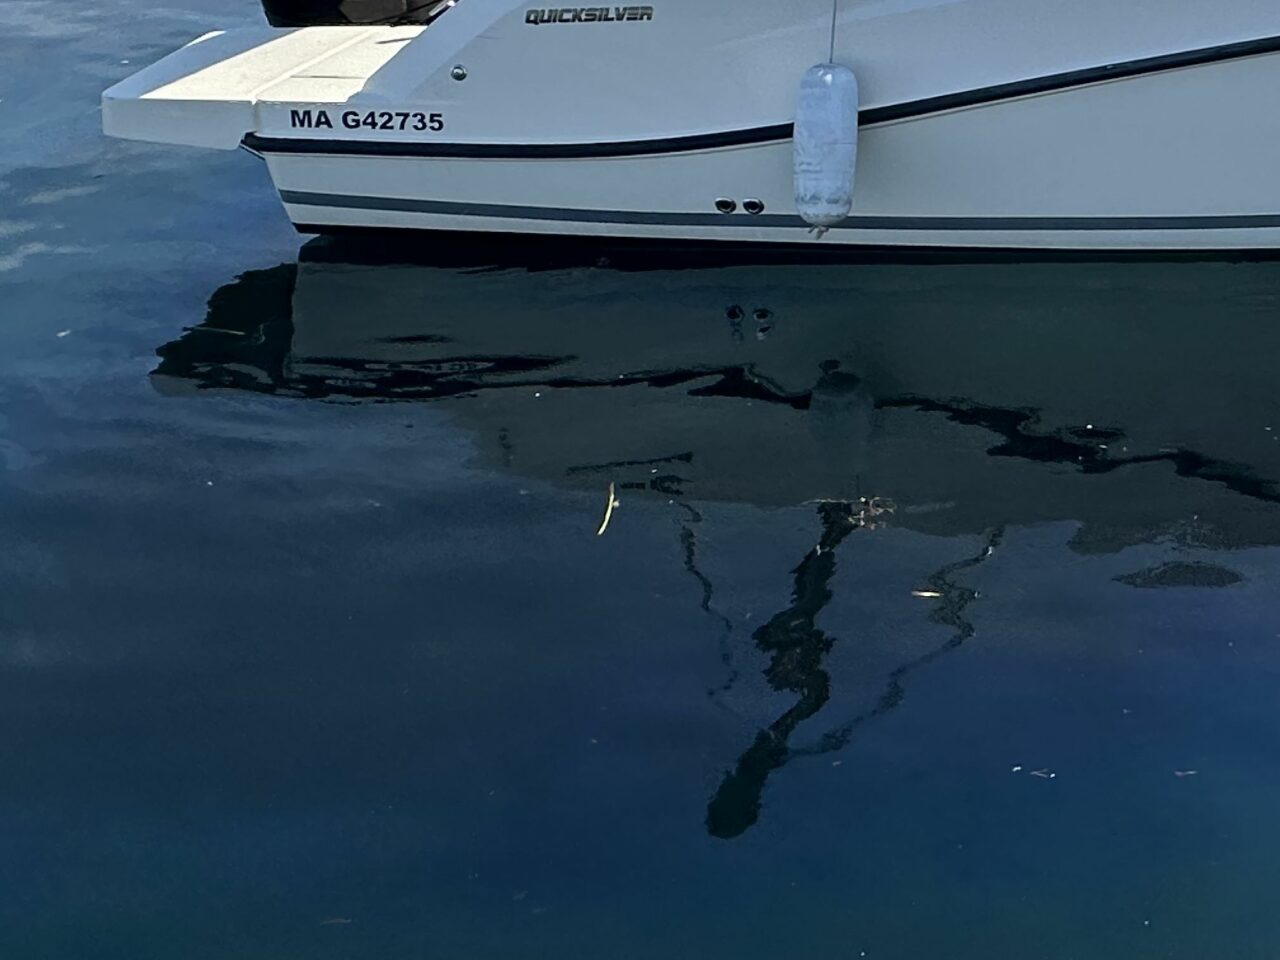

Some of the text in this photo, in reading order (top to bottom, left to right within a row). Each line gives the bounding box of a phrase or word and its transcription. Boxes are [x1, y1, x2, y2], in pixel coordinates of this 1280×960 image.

[525, 6, 654, 25] QUICKSILVER
[290, 109, 444, 131] MA G42735
